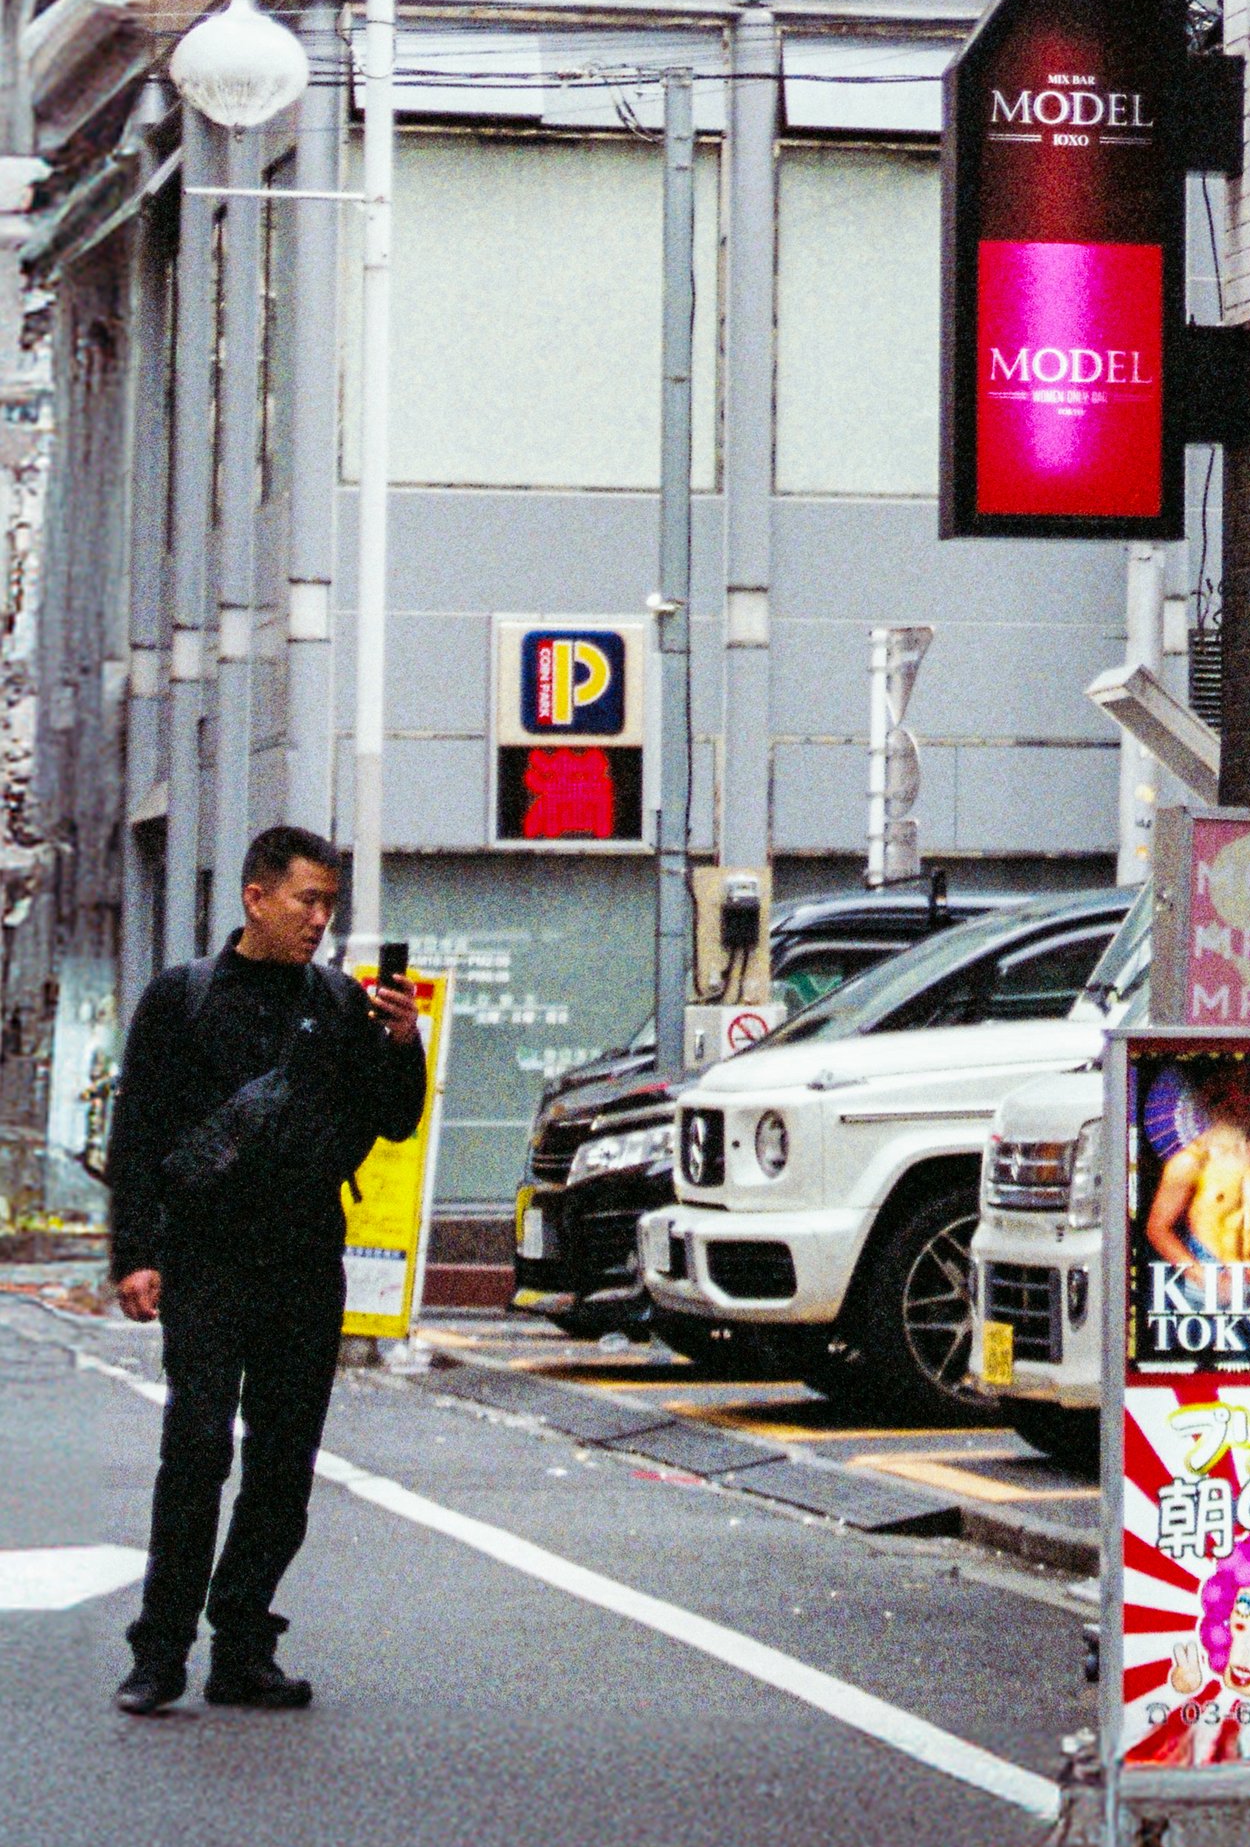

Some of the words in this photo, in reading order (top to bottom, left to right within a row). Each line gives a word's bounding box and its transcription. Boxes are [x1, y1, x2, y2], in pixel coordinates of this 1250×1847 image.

[1047, 74, 1070, 85] MIX
[1072, 75, 1096, 85] BAR
[990, 89, 1154, 127] MODEL
[990, 347, 1153, 384] MODEL
[538, 647, 552, 682] COIN
[538, 683, 552, 719] PARK
